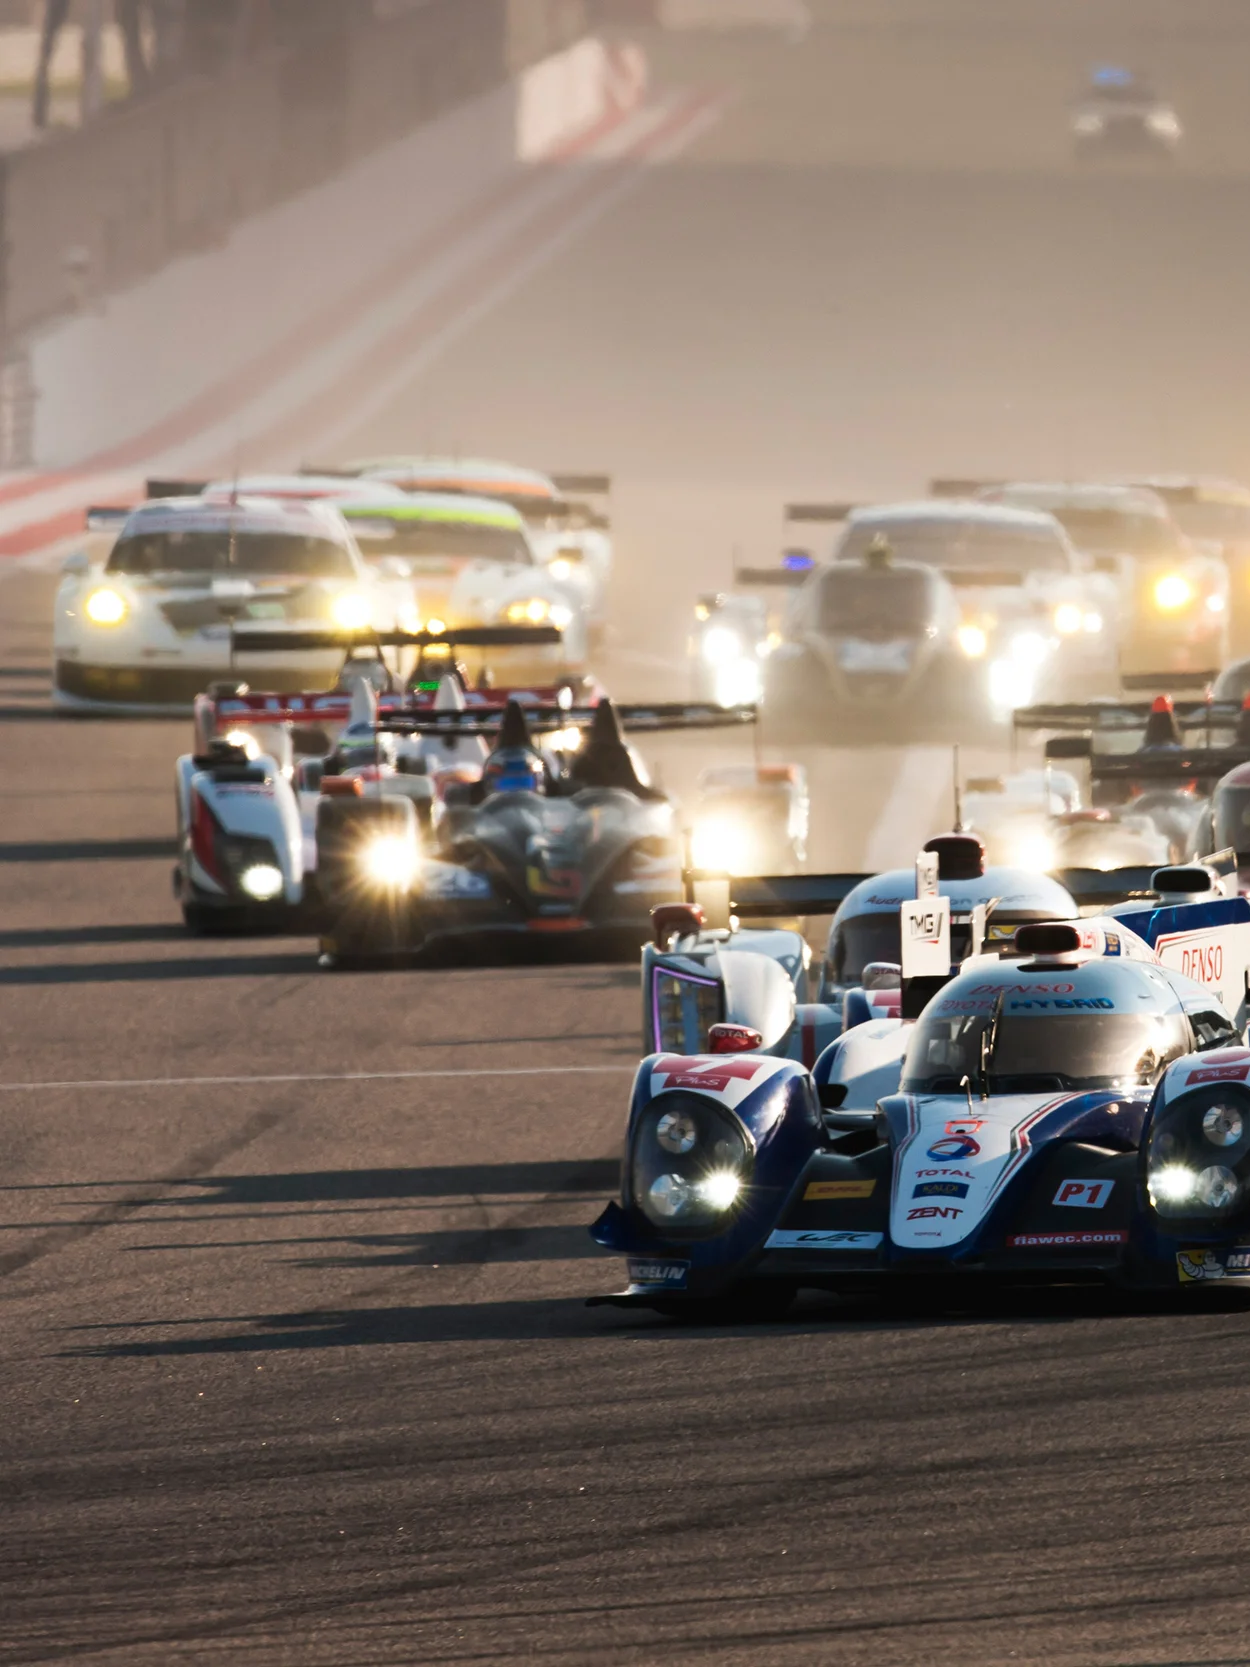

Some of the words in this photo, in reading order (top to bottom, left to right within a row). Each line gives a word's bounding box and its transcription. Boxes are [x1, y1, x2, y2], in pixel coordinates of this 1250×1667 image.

[1182, 945, 1223, 983] DENSO
[968, 983, 1075, 996] DENSO
[1011, 998, 1115, 1010] HYBRID
[686, 1058, 736, 1073] 7
[916, 1169, 976, 1179] TOTAL
[1059, 1183, 1103, 1204] P1
[906, 1206, 964, 1221] ZENT
[1014, 1234, 1121, 1245] fiawec.com
